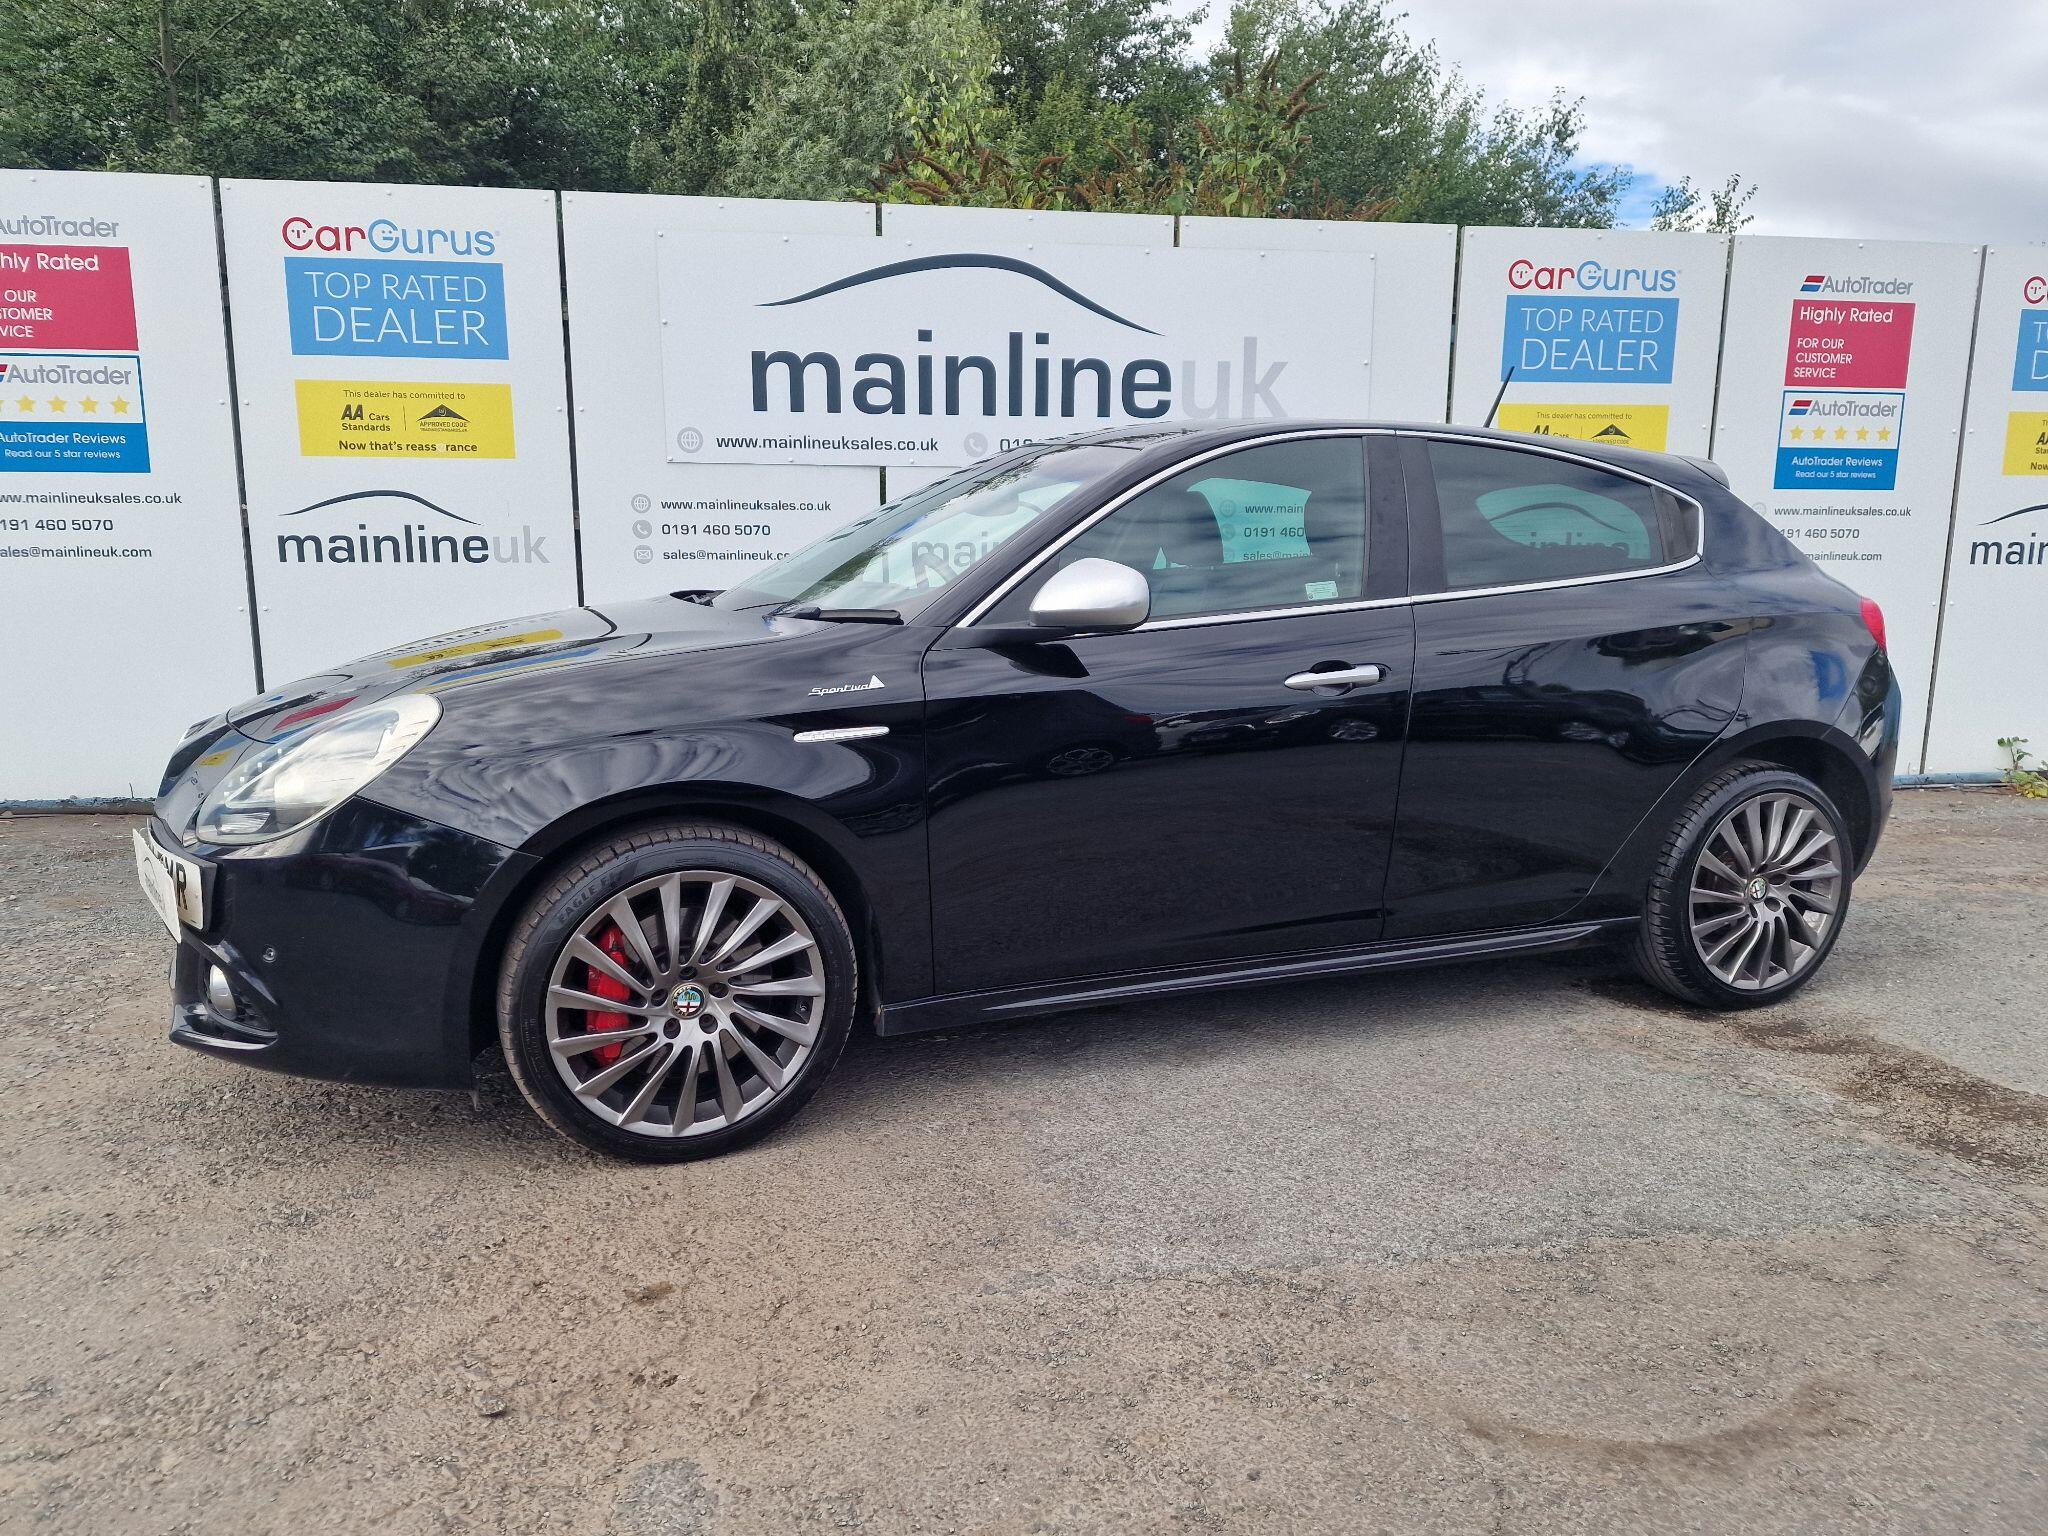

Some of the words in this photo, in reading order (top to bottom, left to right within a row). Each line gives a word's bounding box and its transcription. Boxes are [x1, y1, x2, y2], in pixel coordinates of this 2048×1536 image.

[282, 216, 496, 256] CarGurus
[36, 252, 99, 271] Rated
[1508, 259, 1677, 291] CarGurus
[304, 272, 370, 299] TOP
[383, 274, 486, 302] RATED
[1821, 276, 1913, 295] AutoTrader
[4, 289, 37, 302] OUR
[0, 307, 53, 321] TOMER
[1521, 308, 1573, 331] TOP
[1581, 309, 1664, 333] RATED
[1800, 306, 1847, 324] Highly
[1850, 307, 1894, 323] Rated
[313, 306, 489, 345] DEALER
[1797, 338, 1819, 348] FOR
[1821, 338, 1845, 349] OUR
[1521, 338, 1658, 371] DEALER
[1795, 352, 1853, 364] CUSTOMER
[7, 364, 131, 385] AutoTrader
[751, 329, 1289, 420] mainlineuk
[1794, 367, 1836, 378] SERVICE
[343, 390, 362, 398] This
[364, 390, 390, 398] dealer
[393, 391, 407, 399] has
[410, 392, 455, 400] committed
[341, 404, 364, 421] AA
[369, 413, 390, 421] Cars
[1809, 400, 1897, 418] AutoTrader
[342, 423, 391, 432] Standards
[73, 432, 126, 444] Reviews
[716, 434, 938, 452] www.mainlineuksales.co.uk
[339, 440, 366, 450] Now
[369, 441, 402, 451] that's
[5, 449, 32, 457] Read
[55, 450, 61, 458] 5
[63, 450, 81, 458] star
[84, 450, 121, 459] reviews
[1791, 456, 1843, 466] AutoTrader
[1845, 457, 1883, 467] Reviews
[1795, 470, 1815, 478] Read
[1851, 471, 1876, 479] reviews
[661, 499, 831, 511] www.mainlineuksales.co.uk
[1774, 506, 1912, 517] www.mainlineuksales.co.uk
[35, 519, 66, 530] 460
[72, 519, 113, 530] 5070
[662, 524, 697, 535] 0191
[703, 524, 730, 536] 460
[734, 525, 771, 536] 5070
[1244, 527, 1275, 537] 0191
[1280, 527, 1305, 537] 460
[1804, 528, 1827, 539] 460
[1830, 528, 1860, 539] 5070
[277, 524, 550, 564] mainlineuk
